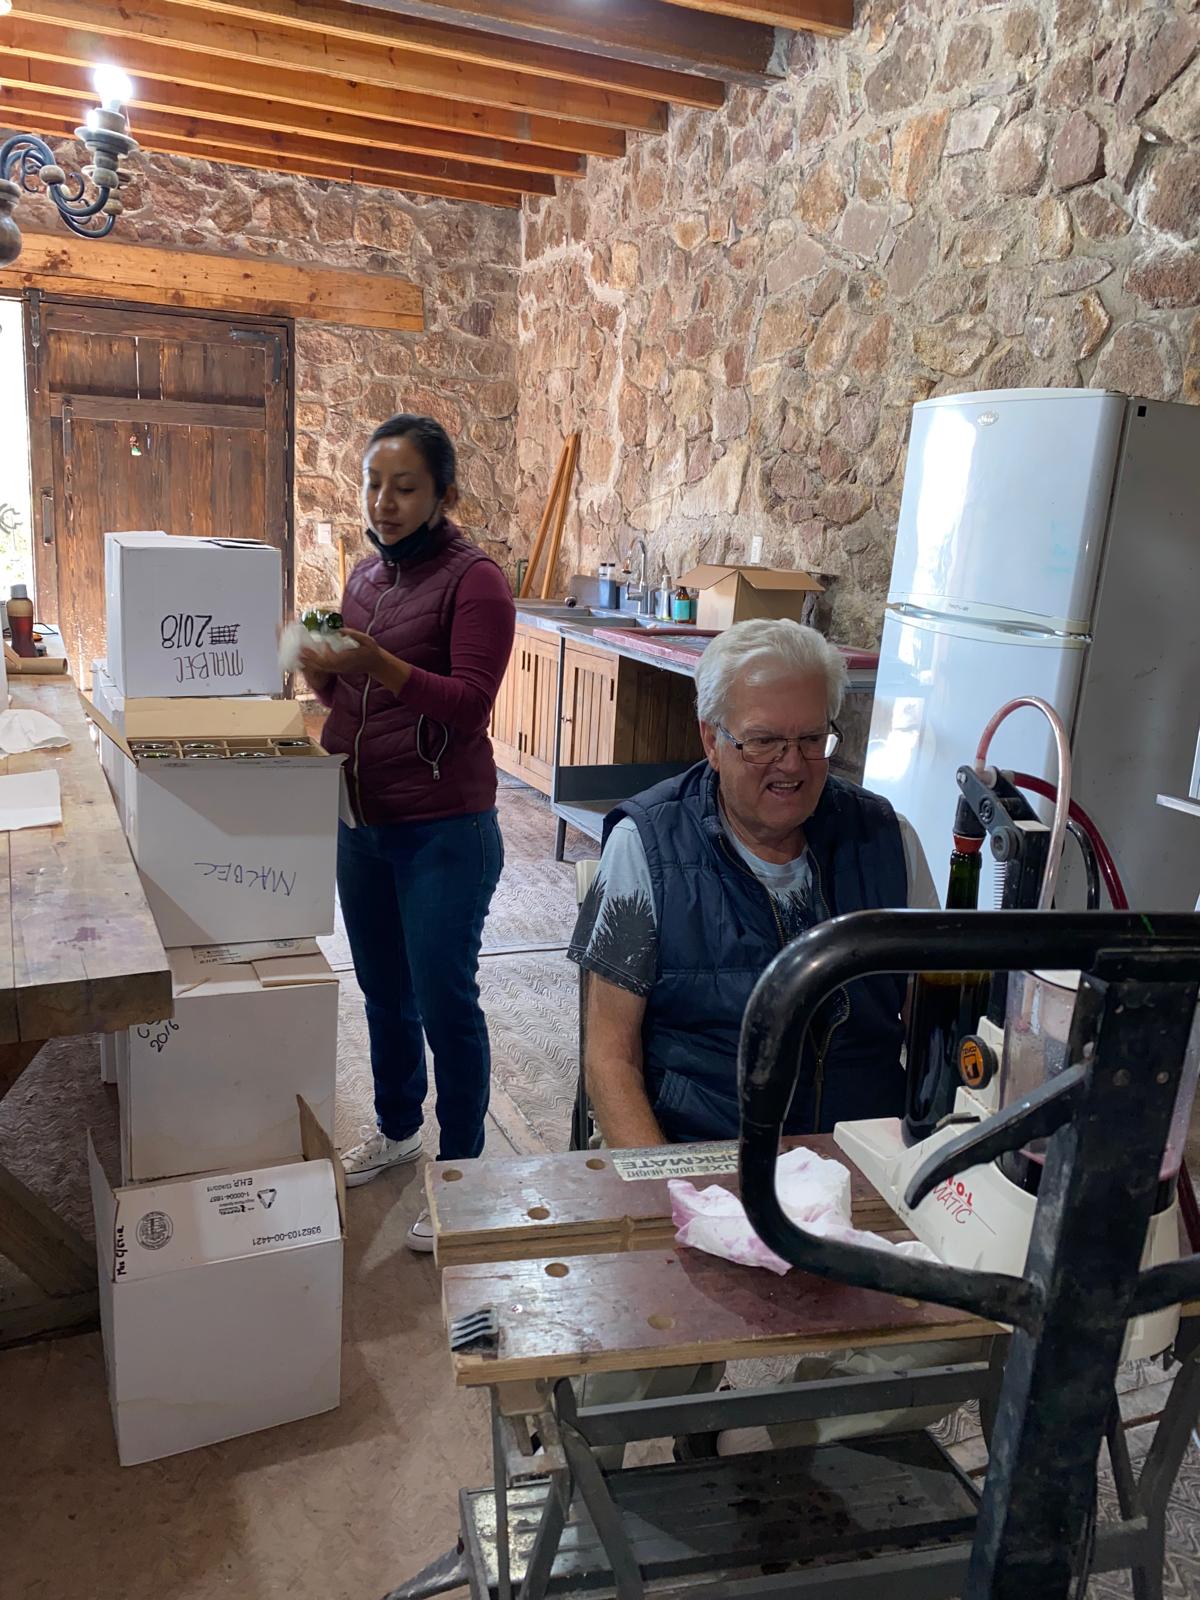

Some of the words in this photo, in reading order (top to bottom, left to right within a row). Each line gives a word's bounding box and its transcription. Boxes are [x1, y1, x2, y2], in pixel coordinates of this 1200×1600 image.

[161, 613, 213, 649] 2018
[173, 649, 244, 684] MALBEC
[150, 1019, 180, 1053] 2016
[621, 1154, 739, 1170] ORKMATE
[626, 1169, 663, 1179] HEIGHT
[666, 1166, 696, 1175] DUAL
